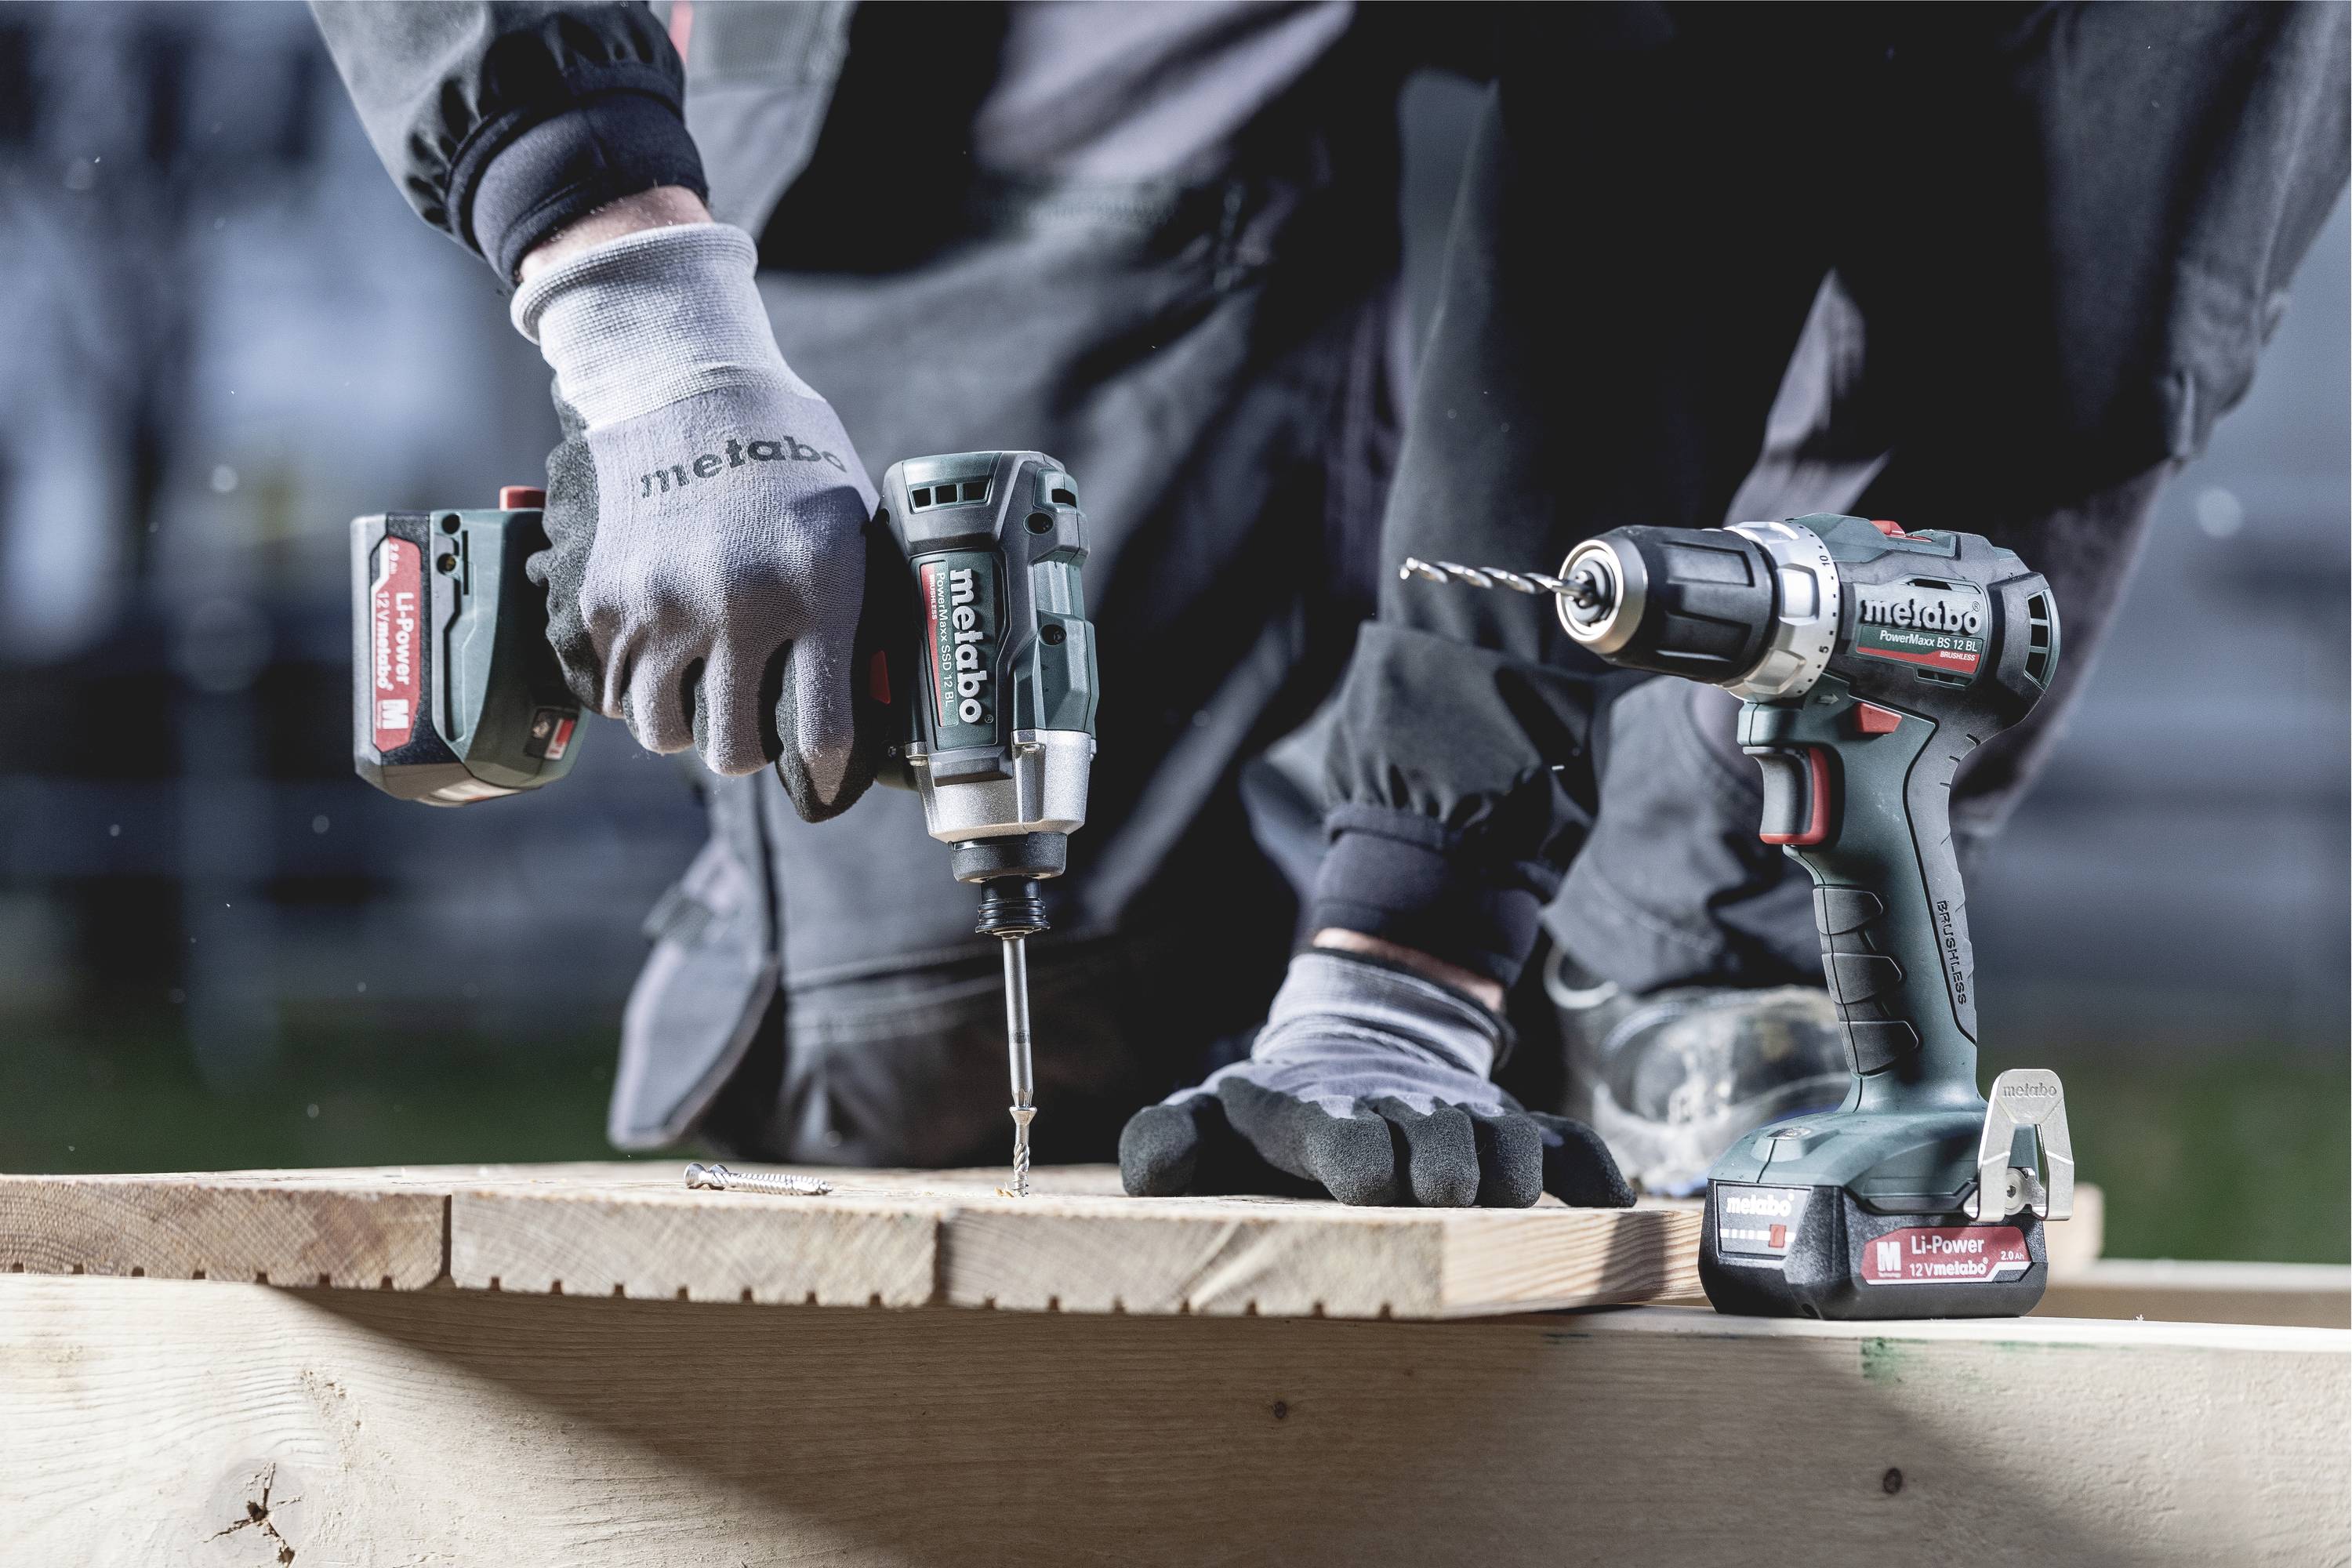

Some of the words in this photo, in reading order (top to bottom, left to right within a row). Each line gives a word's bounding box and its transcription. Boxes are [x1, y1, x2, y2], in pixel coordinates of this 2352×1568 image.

[640, 435, 848, 499] metabo
[1819, 555, 1830, 566] 10
[376, 590, 390, 608] 12
[929, 574, 938, 620] BRUSHLESS
[936, 572, 949, 642] PowerMaxx
[1861, 598, 1981, 635] metabo
[395, 592, 415, 686] Li-Power
[949, 568, 988, 724] metabo
[1879, 630, 1935, 647] PowerMaxx
[1936, 637, 1951, 648] BS
[1953, 639, 1964, 650] 12
[1965, 641, 1978, 652] BL
[942, 644, 952, 671] SSD
[1819, 645, 1829, 654] 5
[1940, 651, 1976, 661] BRUSHLESS
[943, 674, 953, 688] 12
[945, 691, 954, 707] BL
[1936, 900, 1967, 1005] BRUSHLESS
[2003, 1082, 2057, 1098] metabo
[1726, 1193, 1792, 1217] metabo
[1911, 1235, 1985, 1254] Li-Power
[2000, 1250, 2014, 1261] 2.0
[1909, 1263, 1922, 1277] 12
